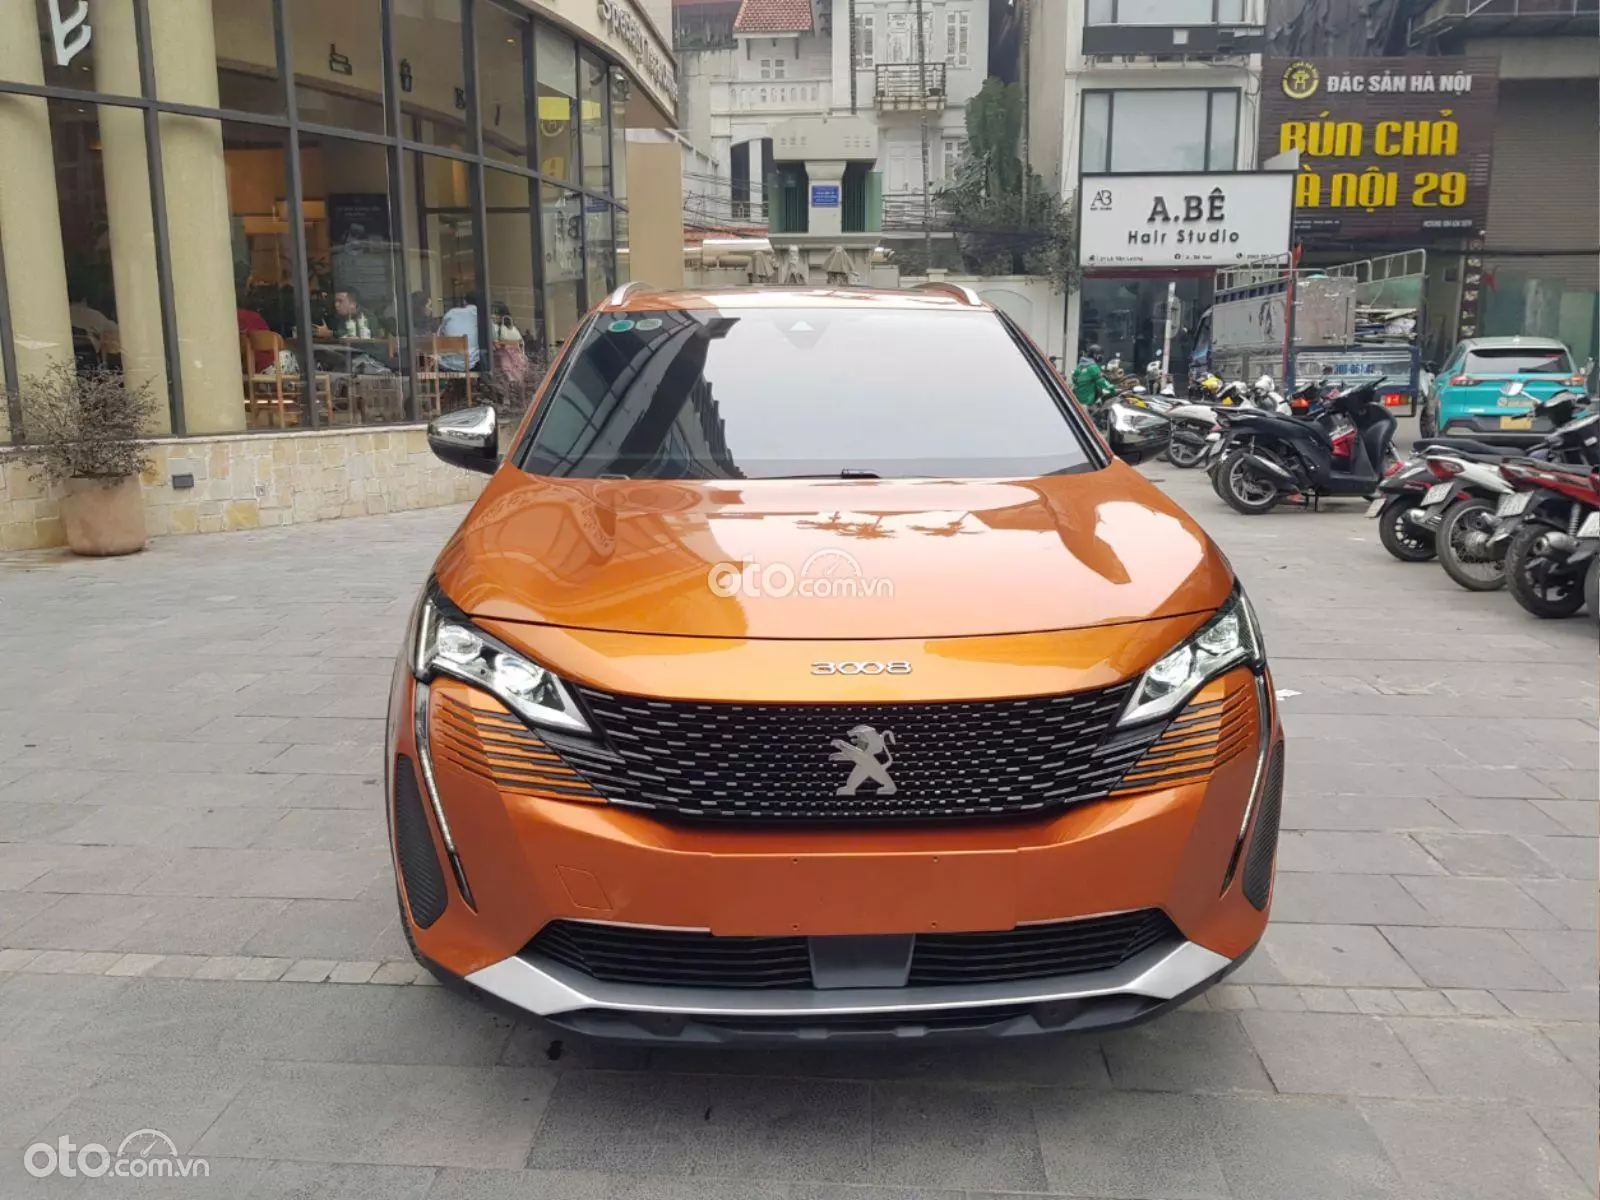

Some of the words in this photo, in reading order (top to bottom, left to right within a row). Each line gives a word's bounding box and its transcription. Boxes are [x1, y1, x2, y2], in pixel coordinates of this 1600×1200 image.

[1368, 70, 1406, 92] SẢN
[1410, 70, 1436, 92] HÀ
[1440, 70, 1472, 96] NỘI
[1279, 110, 1363, 157] BÚN
[1374, 108, 1459, 157] CHẢ
[1295, 164, 1321, 208] À
[1330, 166, 1398, 213] NỘI
[1412, 171, 1467, 207] 29
[1147, 187, 1225, 223] A.BÊ
[1128, 230, 1168, 245] Hair
[1176, 229, 1240, 244] Studio
[811, 660, 913, 676] 3008
